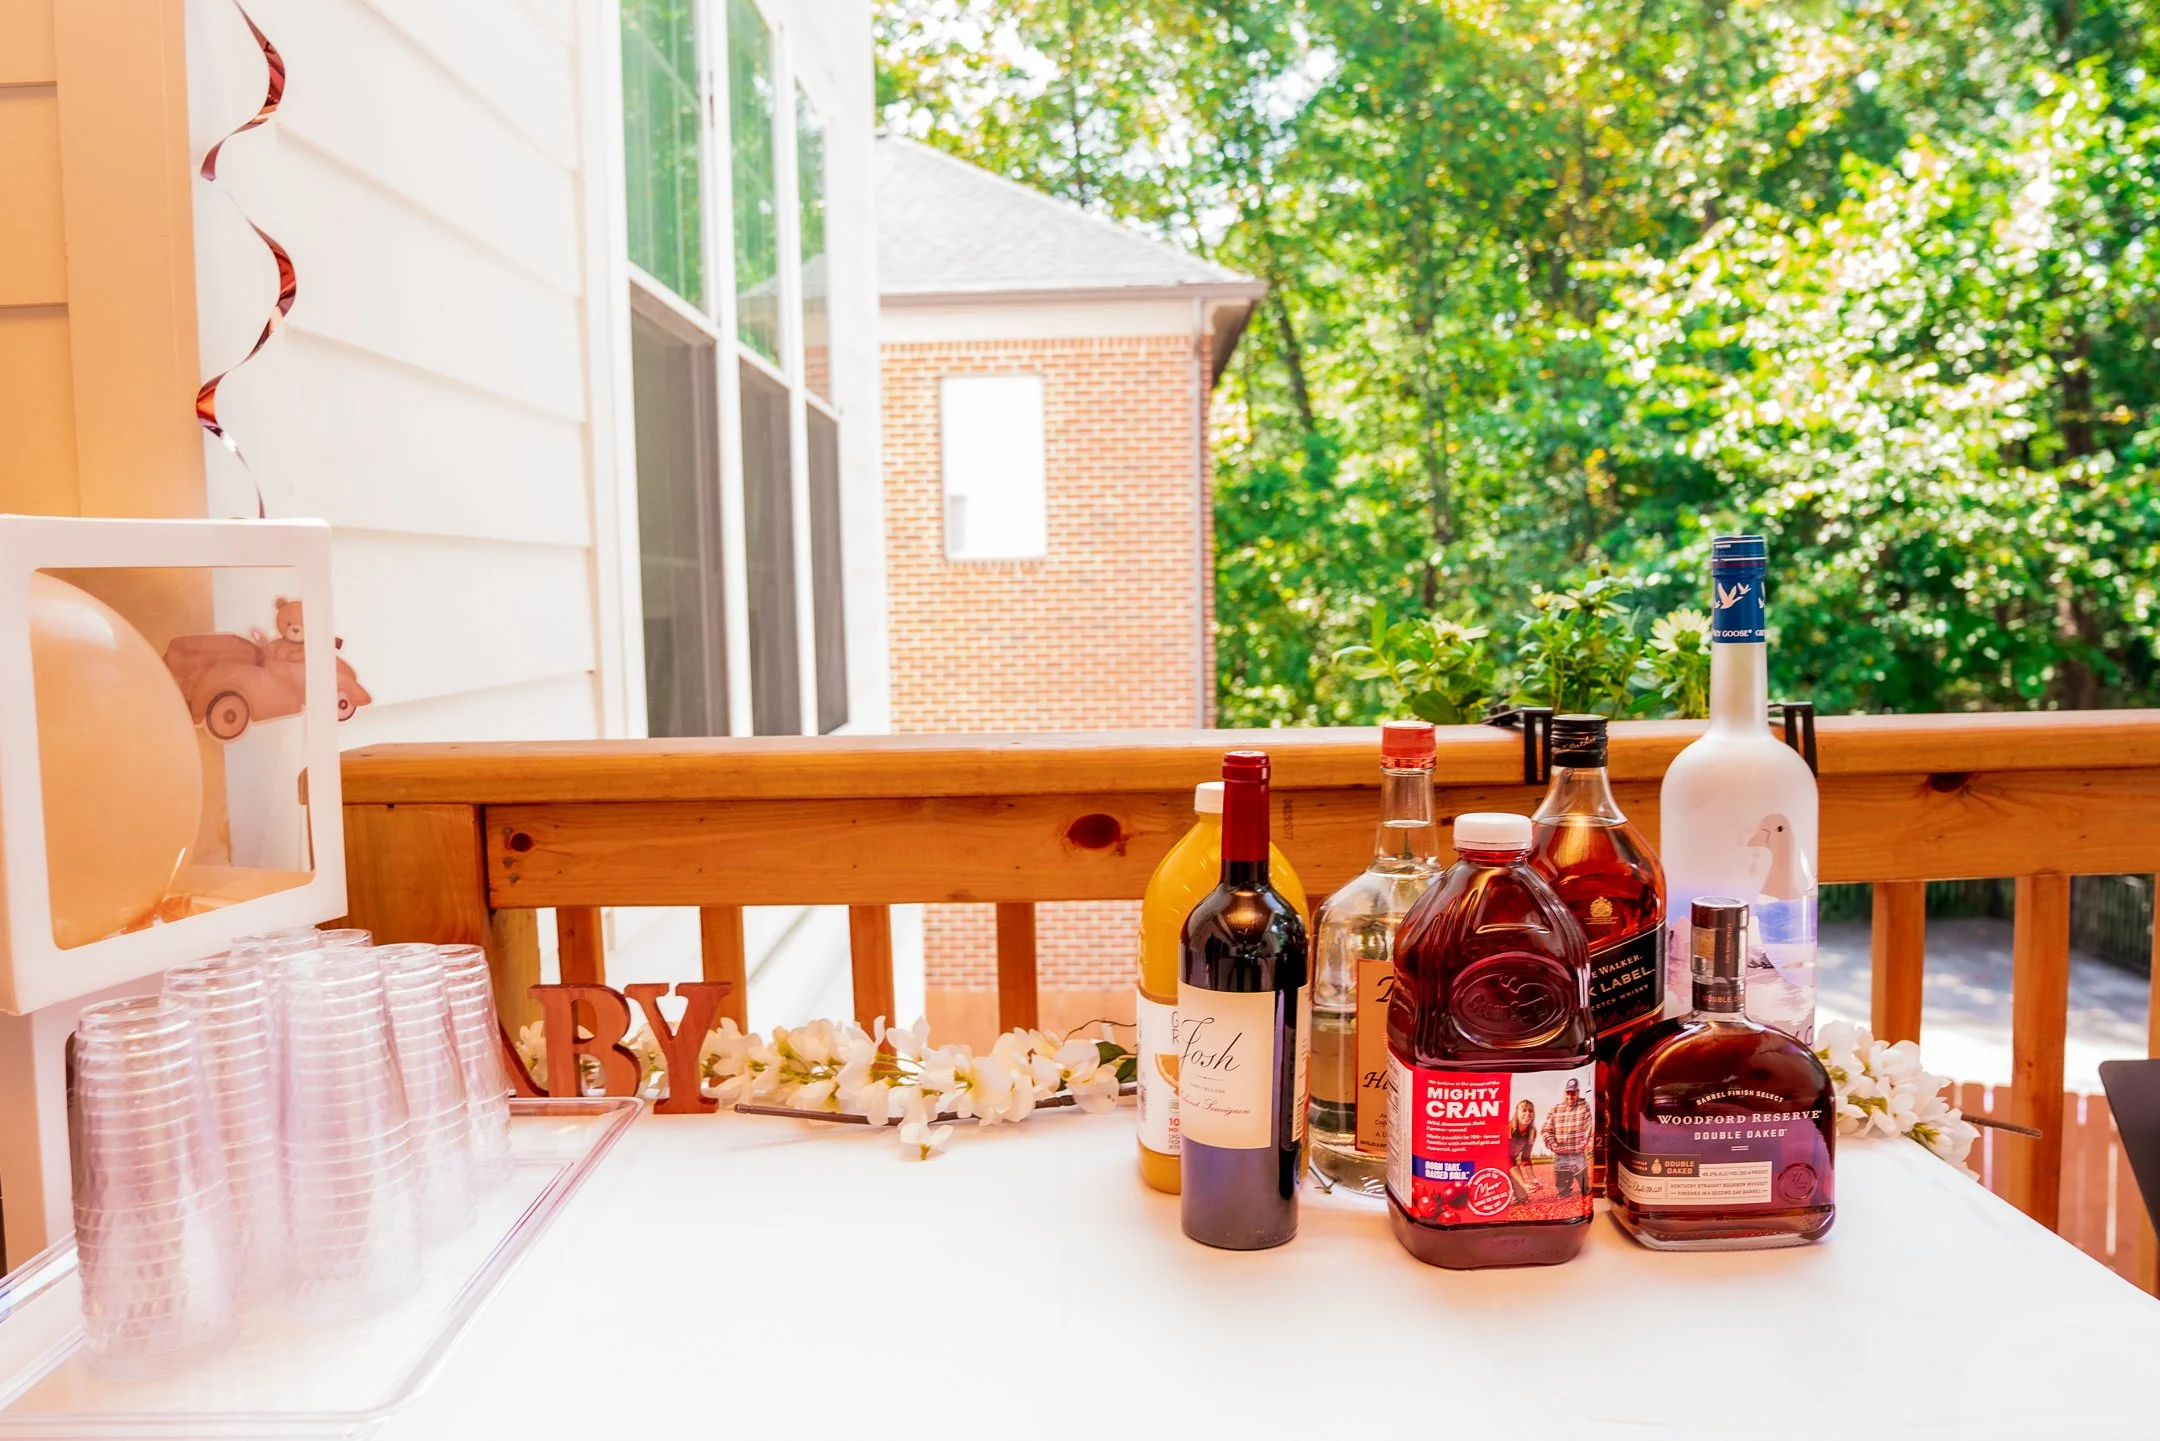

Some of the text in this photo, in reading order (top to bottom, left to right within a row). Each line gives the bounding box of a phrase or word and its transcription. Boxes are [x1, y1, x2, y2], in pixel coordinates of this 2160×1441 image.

[501, 981, 732, 1115] BY
[1180, 1016, 1242, 1073] Josh
[1427, 1086, 1500, 1100] MIGHTY
[1696, 1089, 1784, 1106] BARREL FINISH SELECT
[1425, 1100, 1500, 1119] CRAN
[1657, 1113, 1746, 1126] WOODFORD
[1595, 1136, 1604, 1148] 2
[1694, 1131, 1742, 1141] DOUBLE
[1664, 1160, 1696, 1168] DOUBLE
[1667, 1167, 1693, 1175] OAKED
